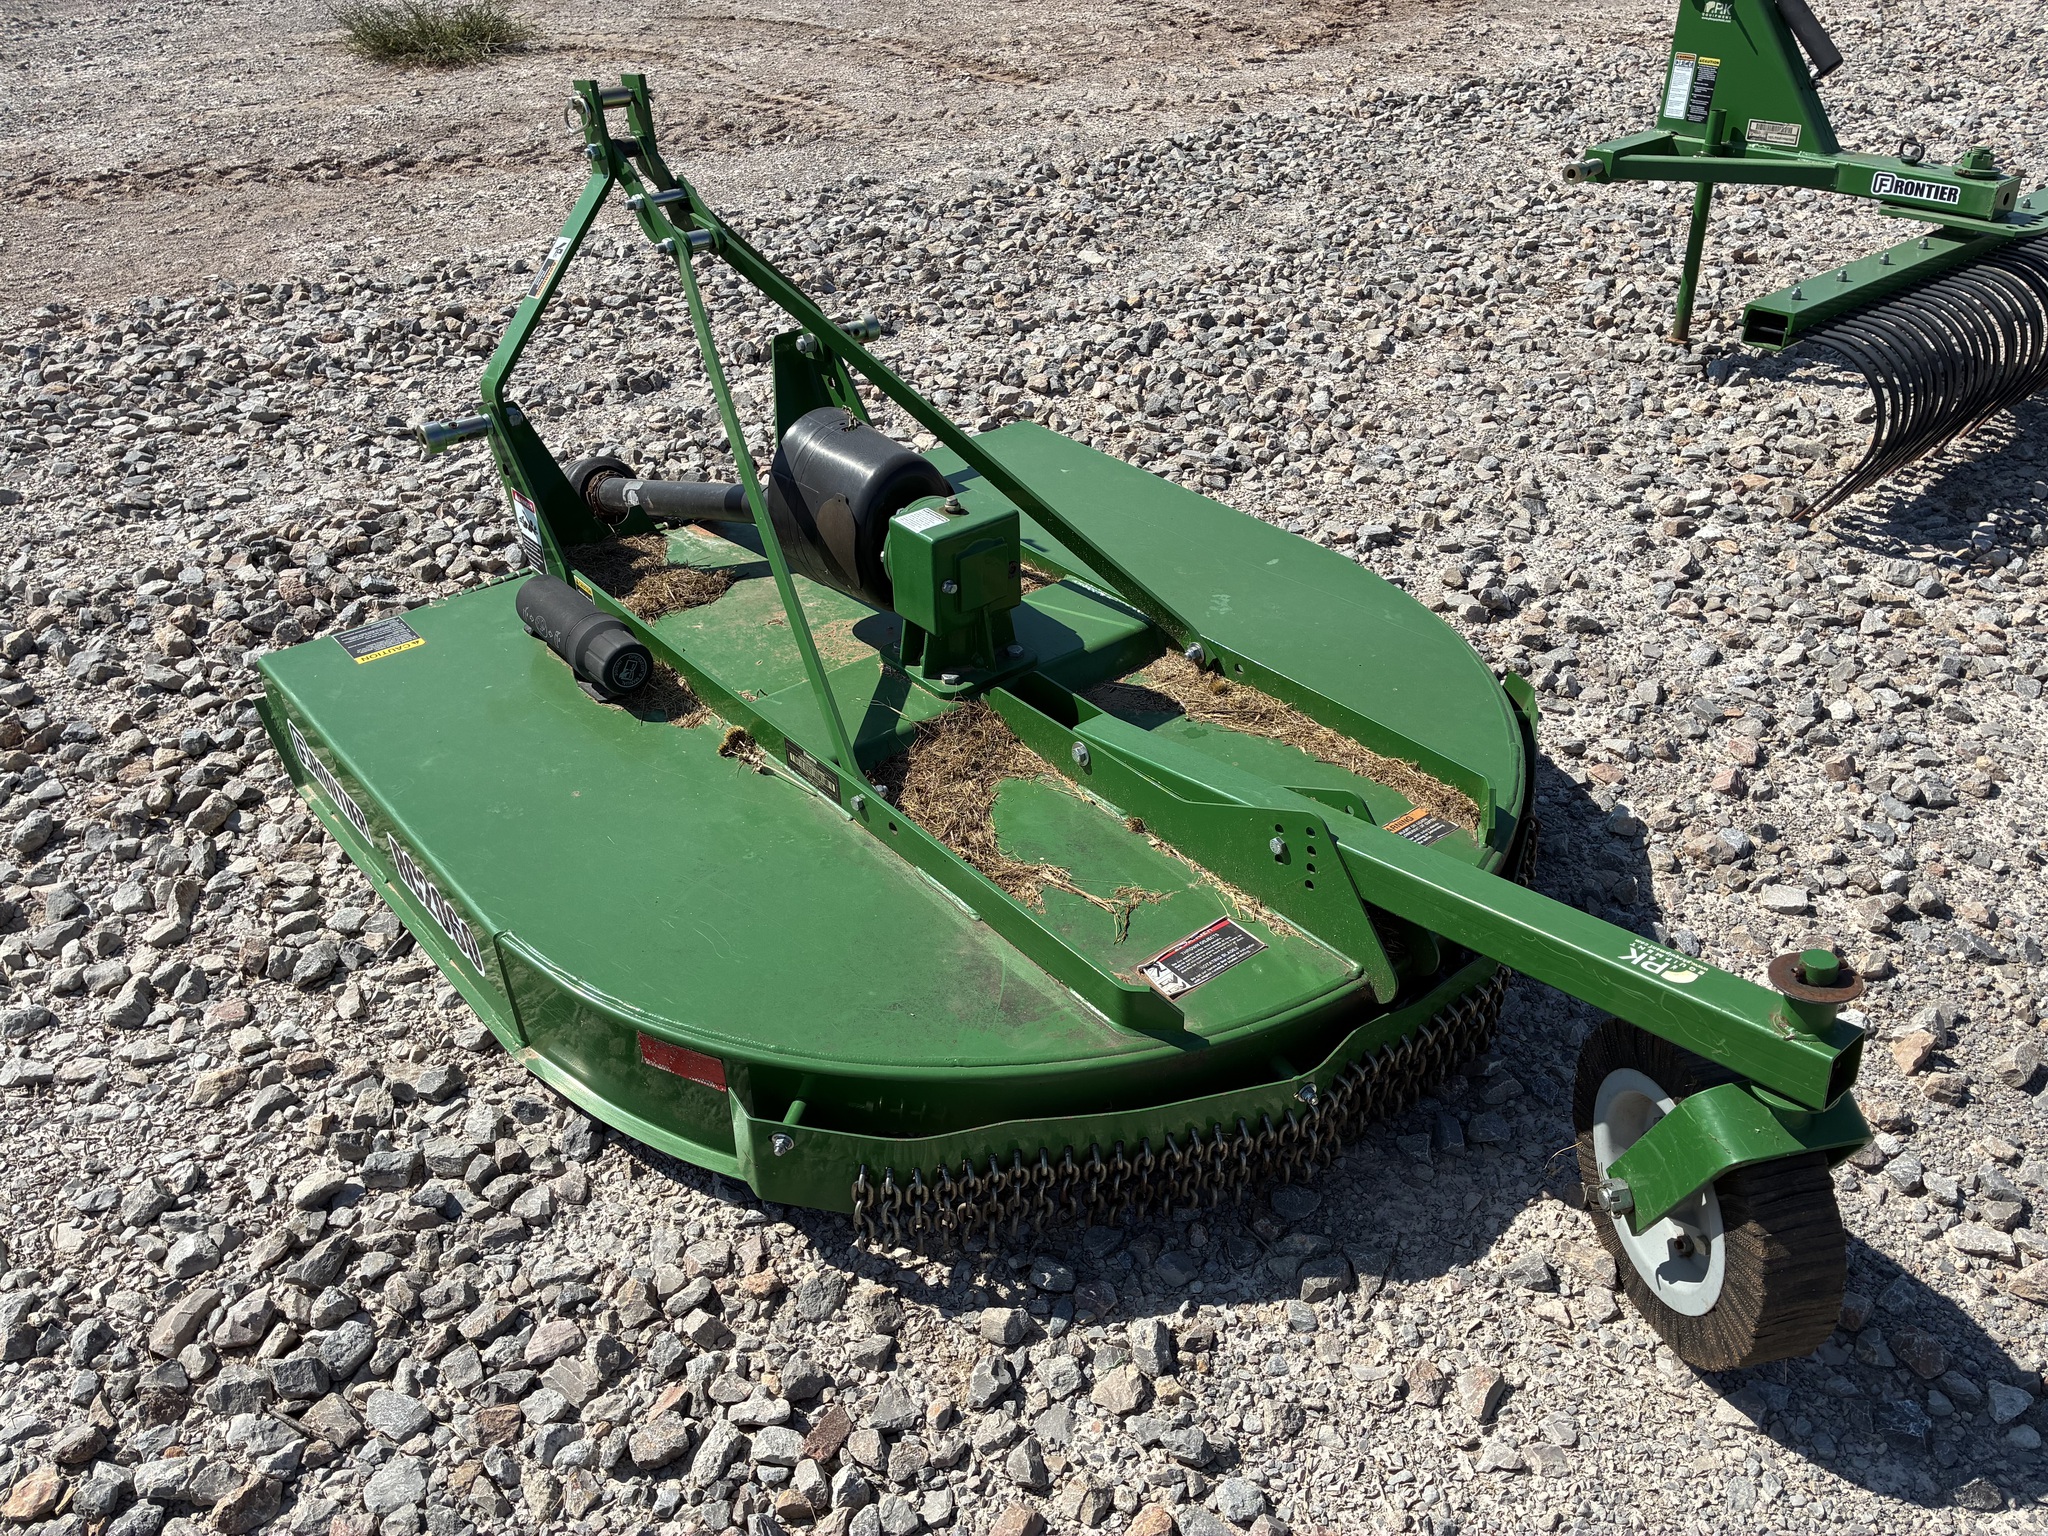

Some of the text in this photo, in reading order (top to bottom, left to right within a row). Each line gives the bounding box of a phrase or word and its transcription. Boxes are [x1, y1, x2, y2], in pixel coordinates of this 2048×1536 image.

[1872, 172, 1959, 203] FRONTIER
[360, 643, 411, 662] CAUTION
[289, 720, 373, 847] FRONTIER
[1386, 815, 1414, 832] ARNING
[388, 834, 484, 975] RC2060
